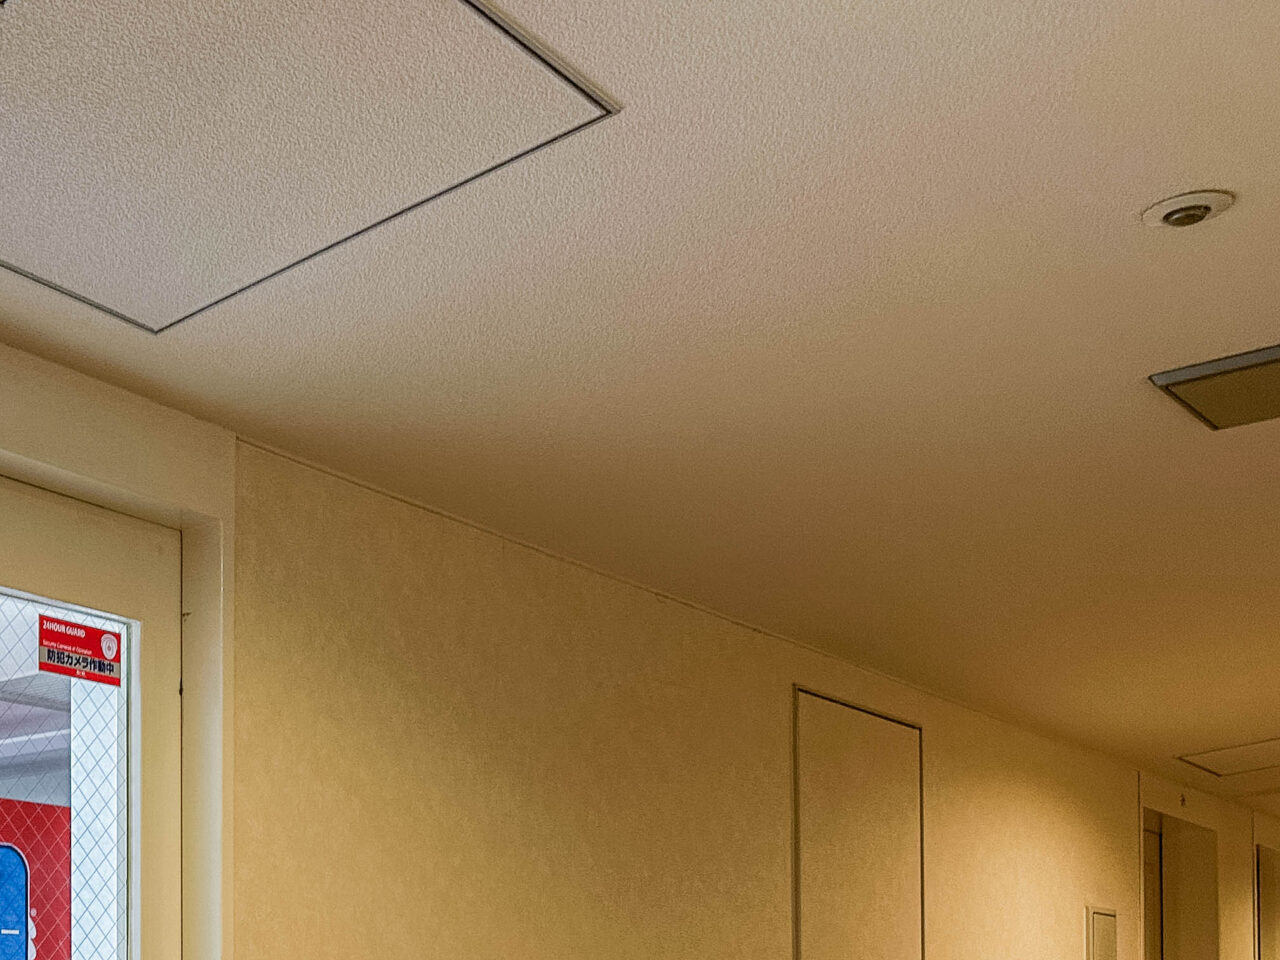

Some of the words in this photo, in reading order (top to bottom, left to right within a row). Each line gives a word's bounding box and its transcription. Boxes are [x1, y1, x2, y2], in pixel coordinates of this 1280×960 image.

[66, 626, 86, 639] GUARD
[47, 649, 115, 675] 防犯カメラ作動中
